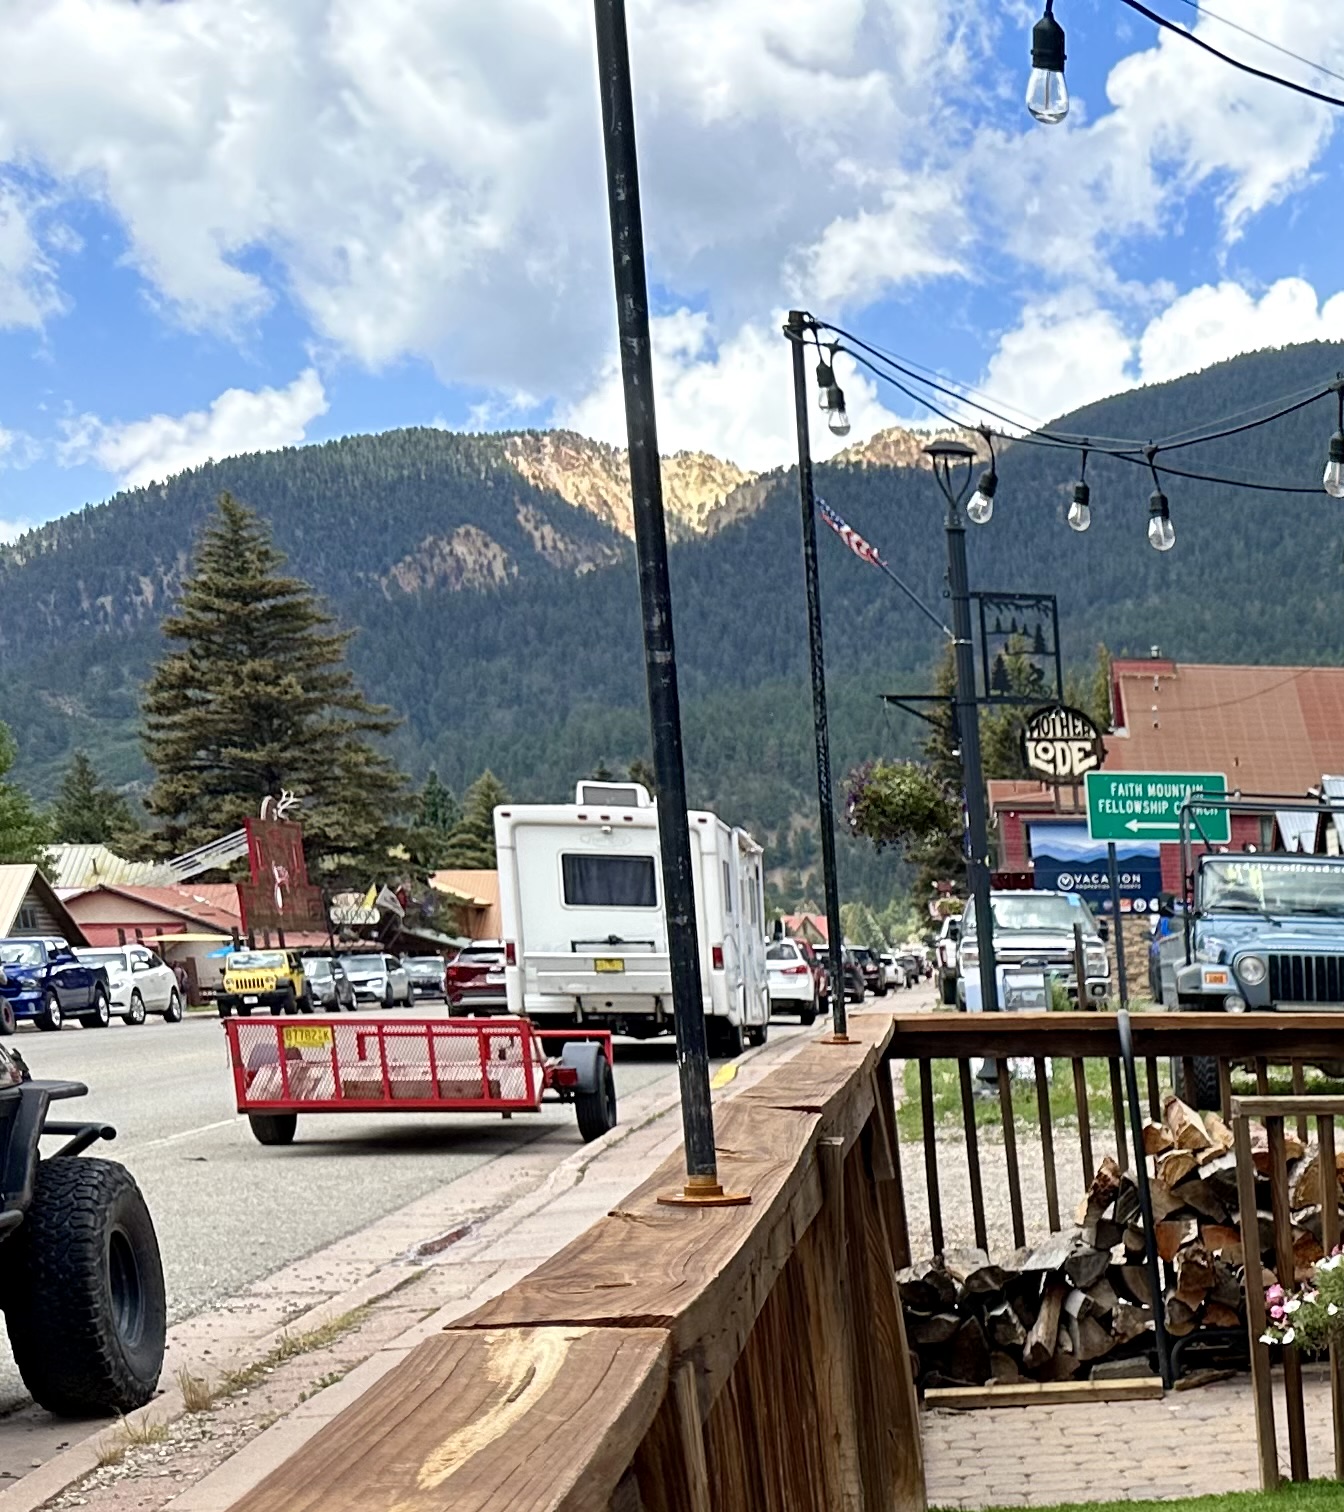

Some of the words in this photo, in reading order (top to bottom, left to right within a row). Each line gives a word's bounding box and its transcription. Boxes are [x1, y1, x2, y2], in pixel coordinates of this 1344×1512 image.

[1026, 741, 1098, 776] LODE
[1110, 782, 1143, 797] FAITH
[1098, 799, 1169, 814] FELLOWSHIP
[1074, 873, 1141, 884] VACAION
